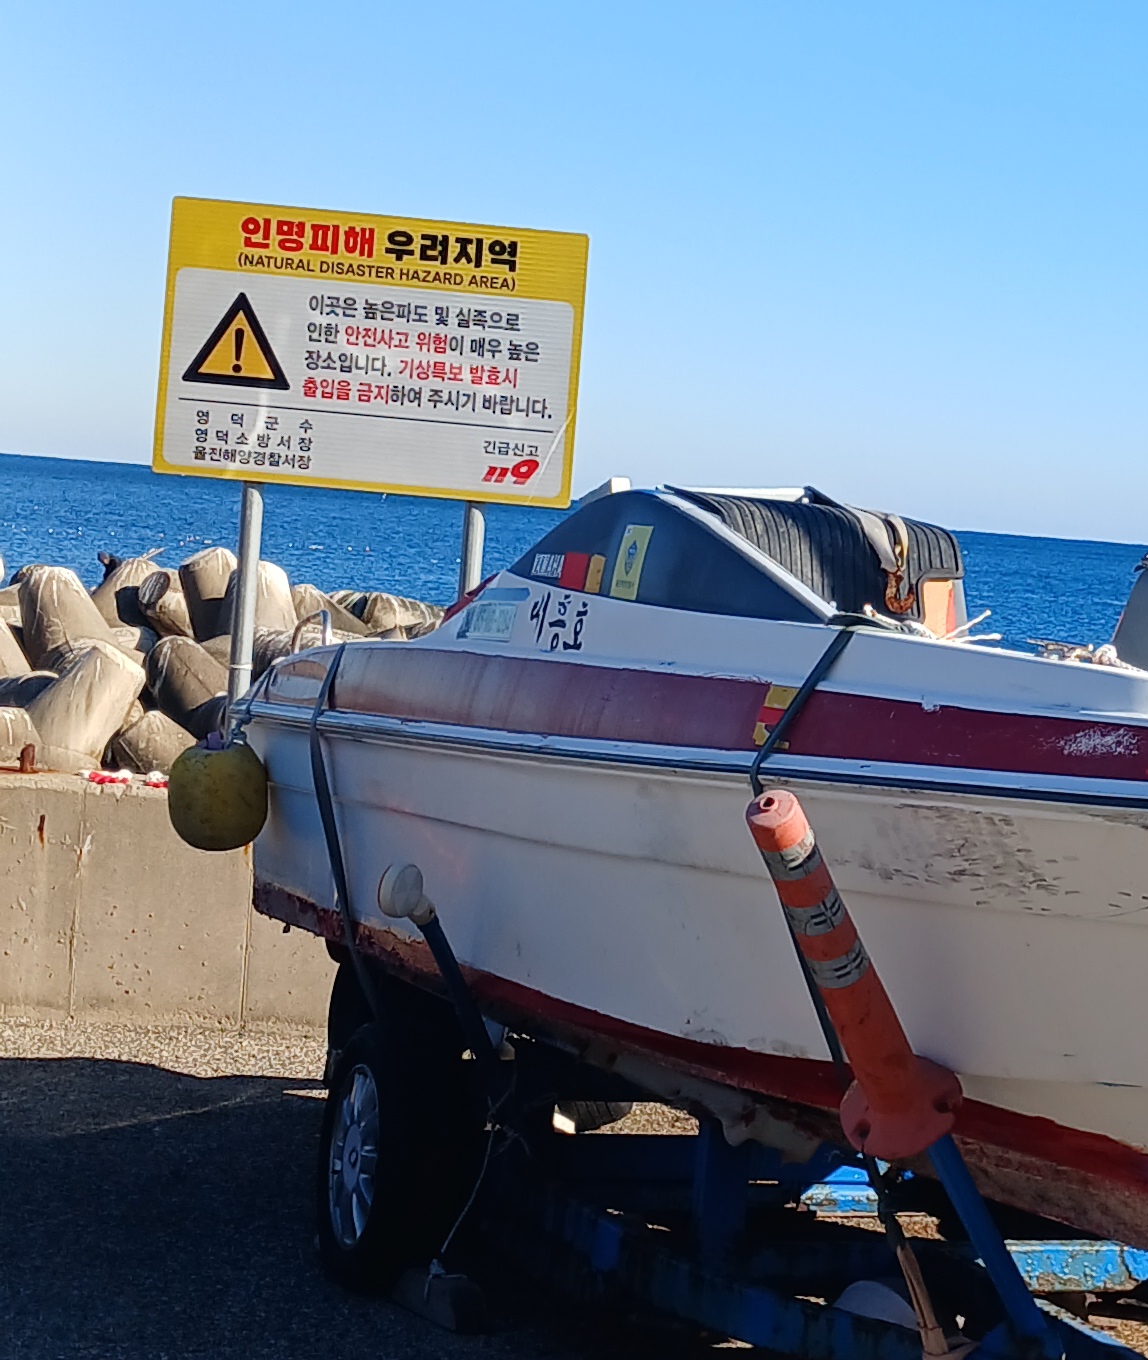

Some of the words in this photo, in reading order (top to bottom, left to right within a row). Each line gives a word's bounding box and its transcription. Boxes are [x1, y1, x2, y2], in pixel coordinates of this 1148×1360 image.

[241, 217, 375, 258] 인명피해
[385, 230, 518, 272] 우려지역
[238, 252, 315, 273] (NATURAL
[320, 260, 395, 280] DISASTER
[400, 268, 464, 286] HAZARD
[468, 274, 516, 292] AREA)
[309, 294, 358, 318] 이곳은
[435, 305, 450, 326] 및
[456, 307, 521, 332] 실족으로
[307, 322, 340, 344] 인한
[345, 325, 410, 349] 안전사고
[416, 332, 464, 356] 위험이
[470, 337, 502, 359] 매우
[507, 340, 540, 362] 높은
[304, 349, 392, 377] 장소입니다.
[398, 358, 464, 383] 기상특보
[469, 364, 518, 389] 발효시
[302, 376, 352, 401] 출입을
[357, 382, 422, 407] 금지하여
[427, 388, 477, 413] 주시기
[482, 393, 552, 419] 바랍니다.
[192, 445, 311, 470] 울진해양경찰서장
[483, 440, 540, 457] 긴급신고
[481, 459, 539, 485] 119
